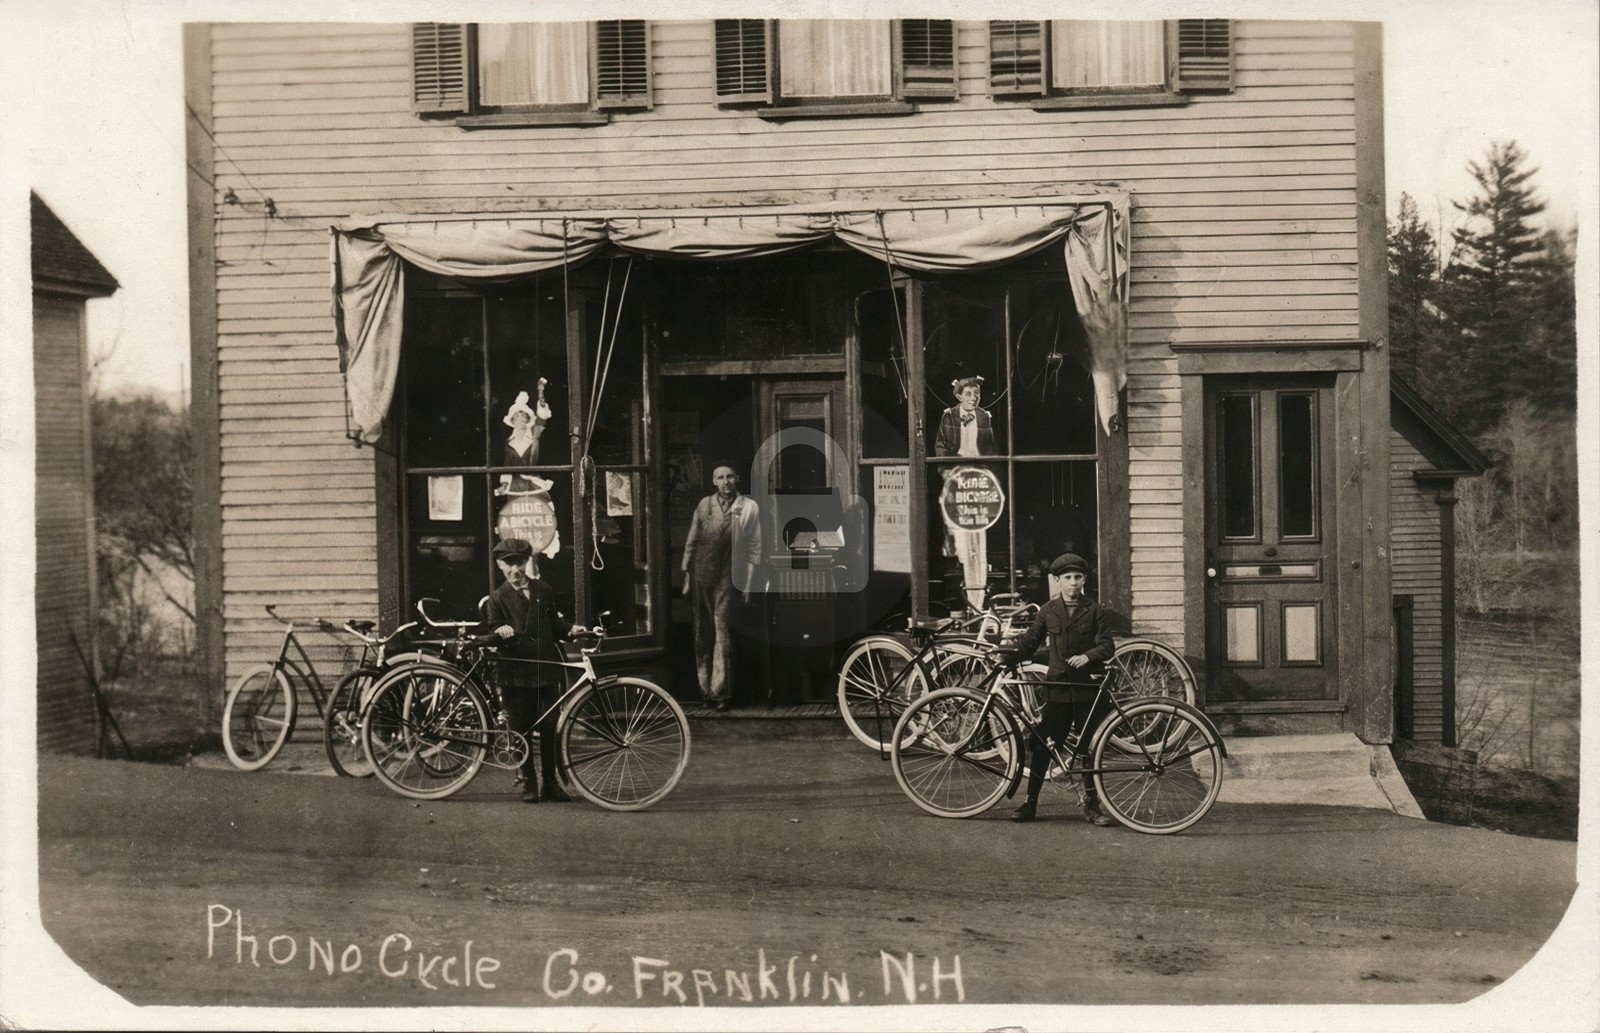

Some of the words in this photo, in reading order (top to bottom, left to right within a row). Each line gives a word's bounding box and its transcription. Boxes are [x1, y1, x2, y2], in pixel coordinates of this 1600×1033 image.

[511, 502, 542, 514] RIDE
[500, 516, 510, 529] A
[510, 515, 553, 528] BICYCLE
